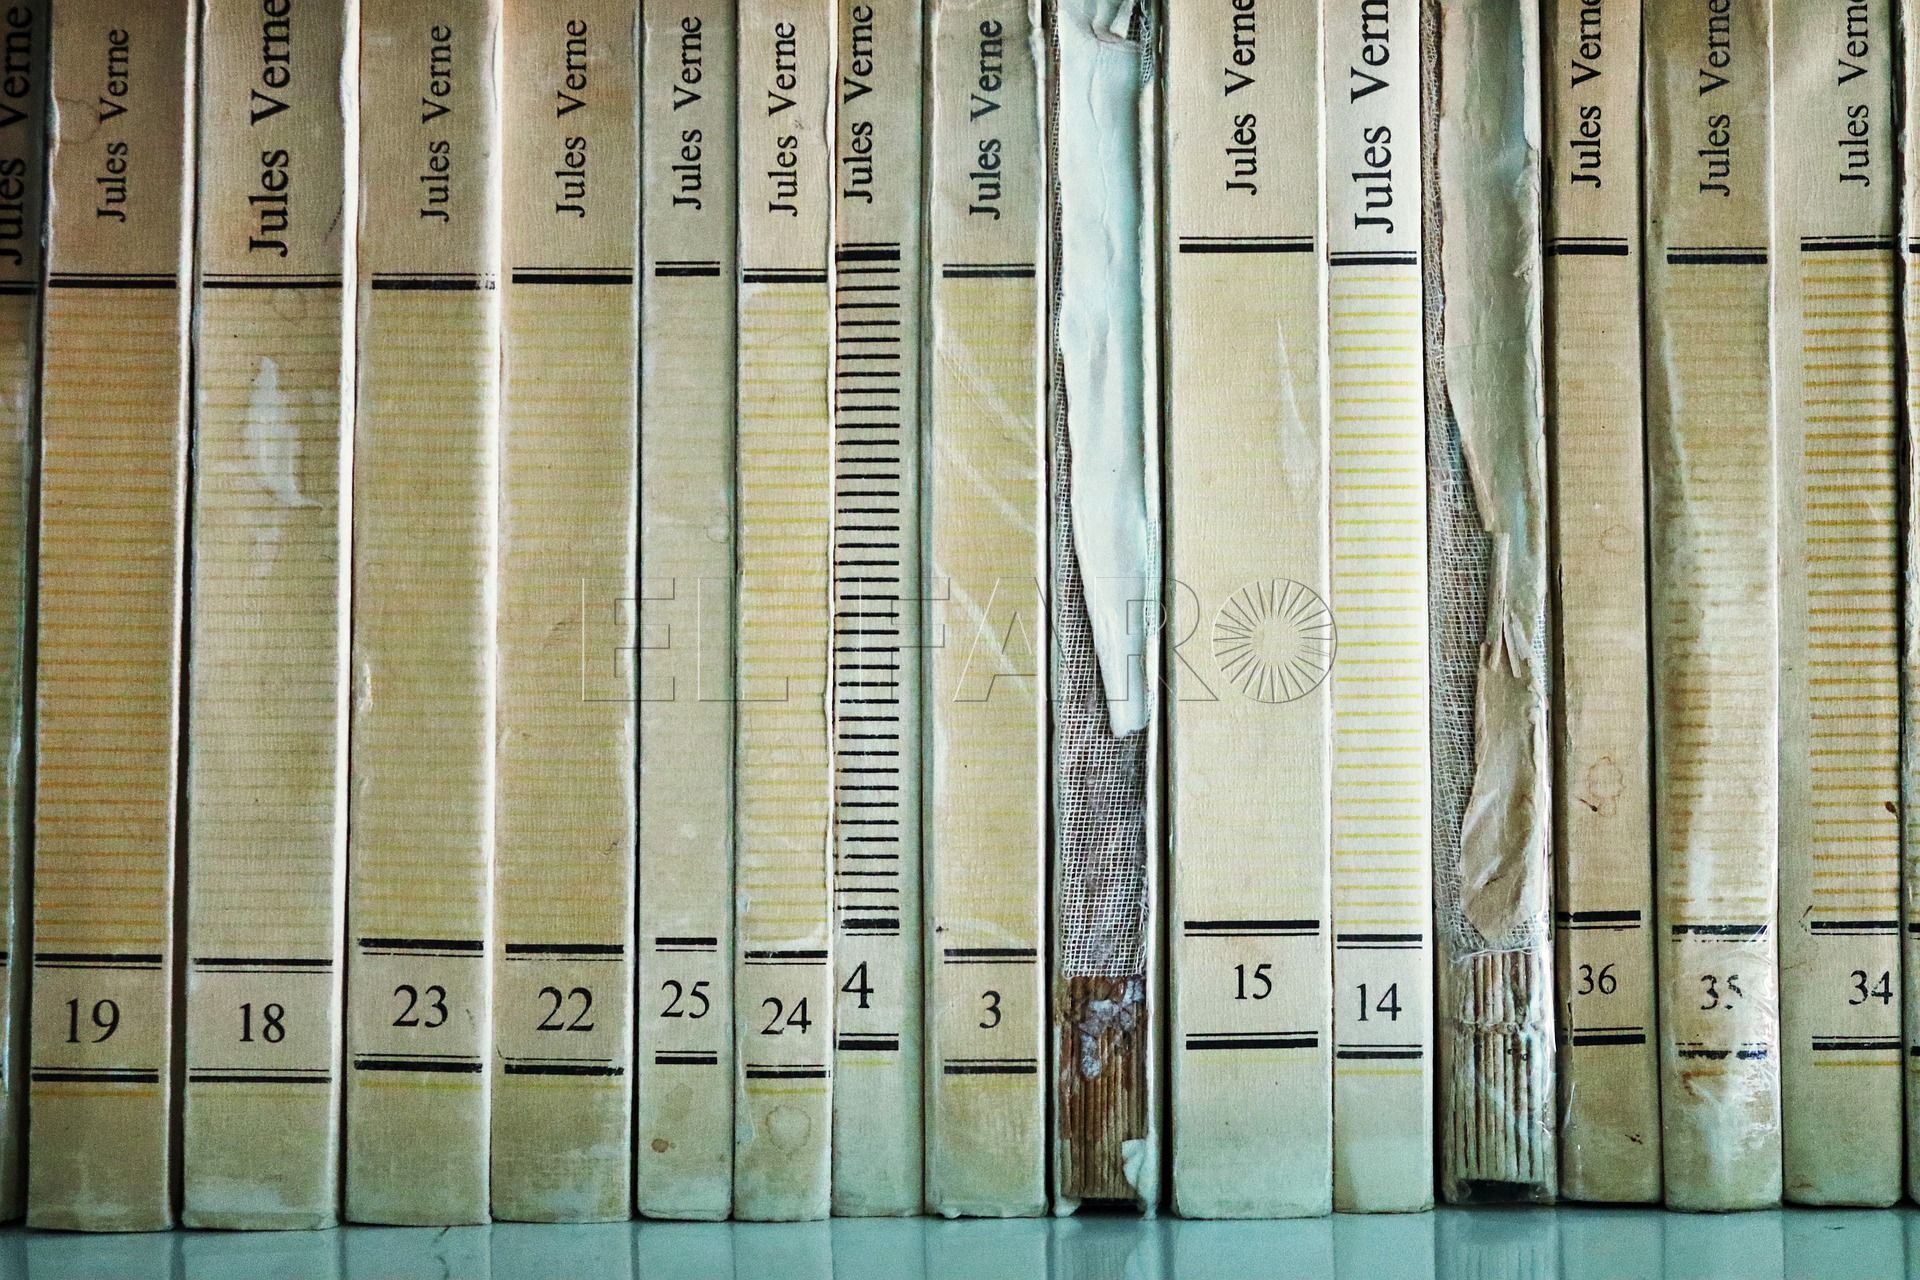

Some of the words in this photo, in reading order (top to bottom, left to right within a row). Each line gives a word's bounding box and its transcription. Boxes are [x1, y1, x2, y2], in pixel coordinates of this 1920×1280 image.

[0, 6, 33, 128] Verne
[99, 29, 129, 125] Verne
[250, 0, 291, 126] Verne
[421, 25, 451, 125] Verne
[556, 19, 587, 119] Verne
[673, 16, 702, 111] Verne
[767, 22, 797, 118] Verne
[843, 5, 873, 105] Verne
[970, 19, 1003, 122] Verne
[1700, 0, 1730, 97] Verne
[1838, 0, 1868, 87] Vern
[96, 142, 128, 223] Jules
[419, 140, 449, 223] Jules
[554, 136, 586, 218] Jules
[671, 129, 702, 211] Jules
[767, 135, 797, 218] Jules
[842, 121, 872, 204] Jules
[969, 138, 1001, 221] Jules
[1225, 113, 1257, 196] Jules
[1352, 125, 1394, 234] Jules
[1569, 105, 1601, 189] Jules
[1698, 114, 1730, 197] Jules
[1839, 104, 1870, 188] Jules
[0, 159, 25, 266] Jules
[248, 149, 289, 258] Jules
[66, 998, 120, 1044] 19
[392, 984, 449, 1028] 23
[537, 986, 595, 1032] 22
[660, 980, 710, 1019] 25
[760, 997, 812, 1035] 24
[840, 960, 875, 1009] 4
[979, 990, 1002, 1029] 3
[1235, 963, 1272, 1000] 15
[1356, 982, 1402, 1022] 14
[1577, 964, 1617, 996] 36
[1848, 970, 1894, 1006] 34
[239, 1002, 286, 1044] 18
